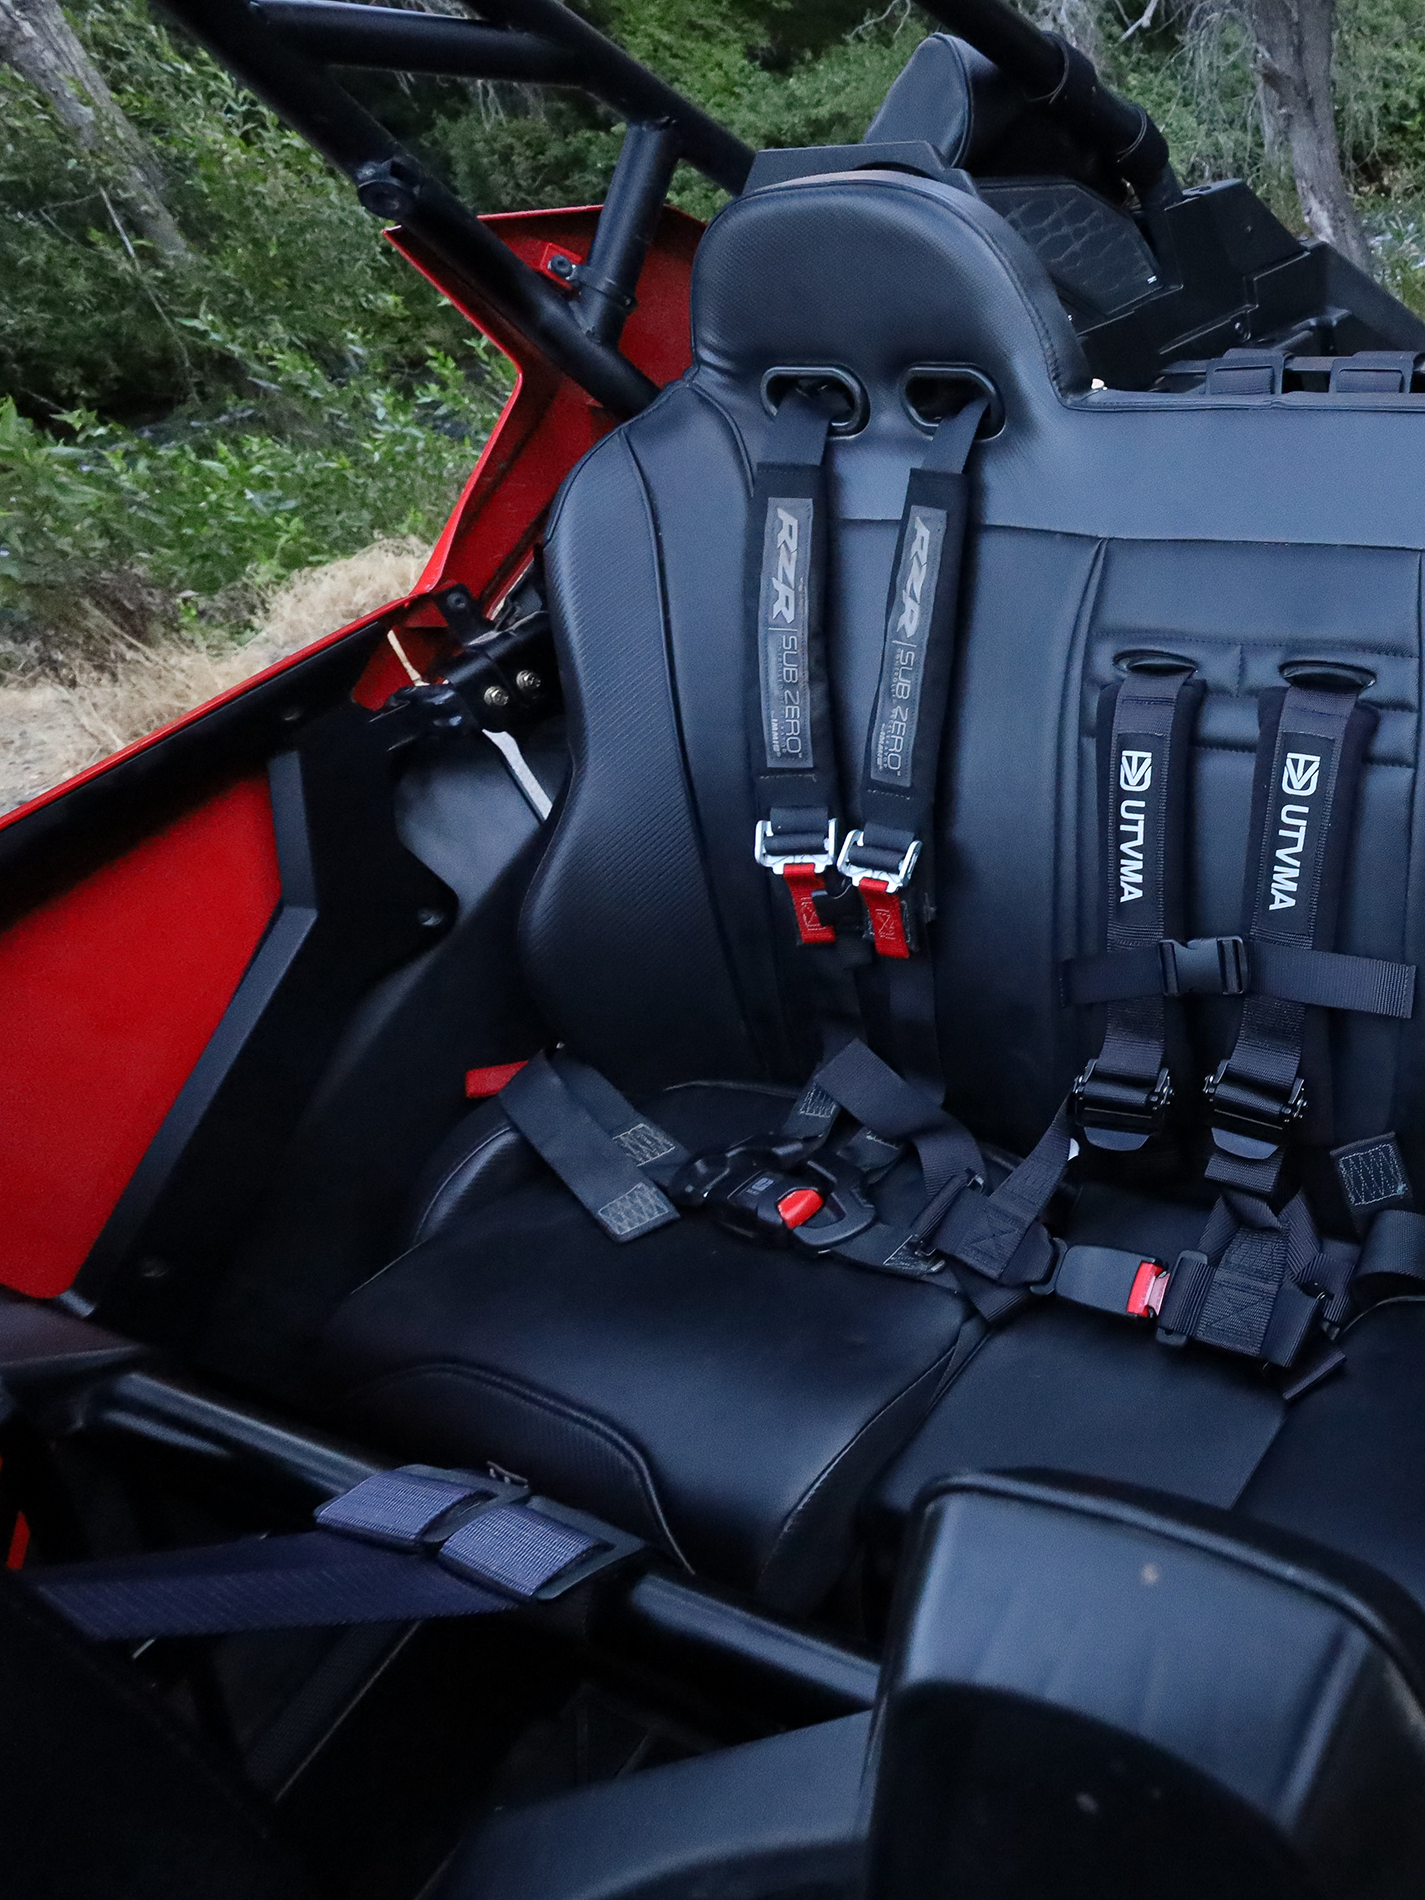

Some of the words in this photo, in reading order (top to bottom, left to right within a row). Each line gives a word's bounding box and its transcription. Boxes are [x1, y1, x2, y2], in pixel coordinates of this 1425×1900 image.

[772, 507, 798, 625] RZR
[896, 516, 930, 639] RZR
[783, 635, 798, 683] SUB
[896, 650, 915, 700] SUB
[1119, 800, 1145, 903] UTVMA
[1269, 804, 1309, 911] UTVMA
